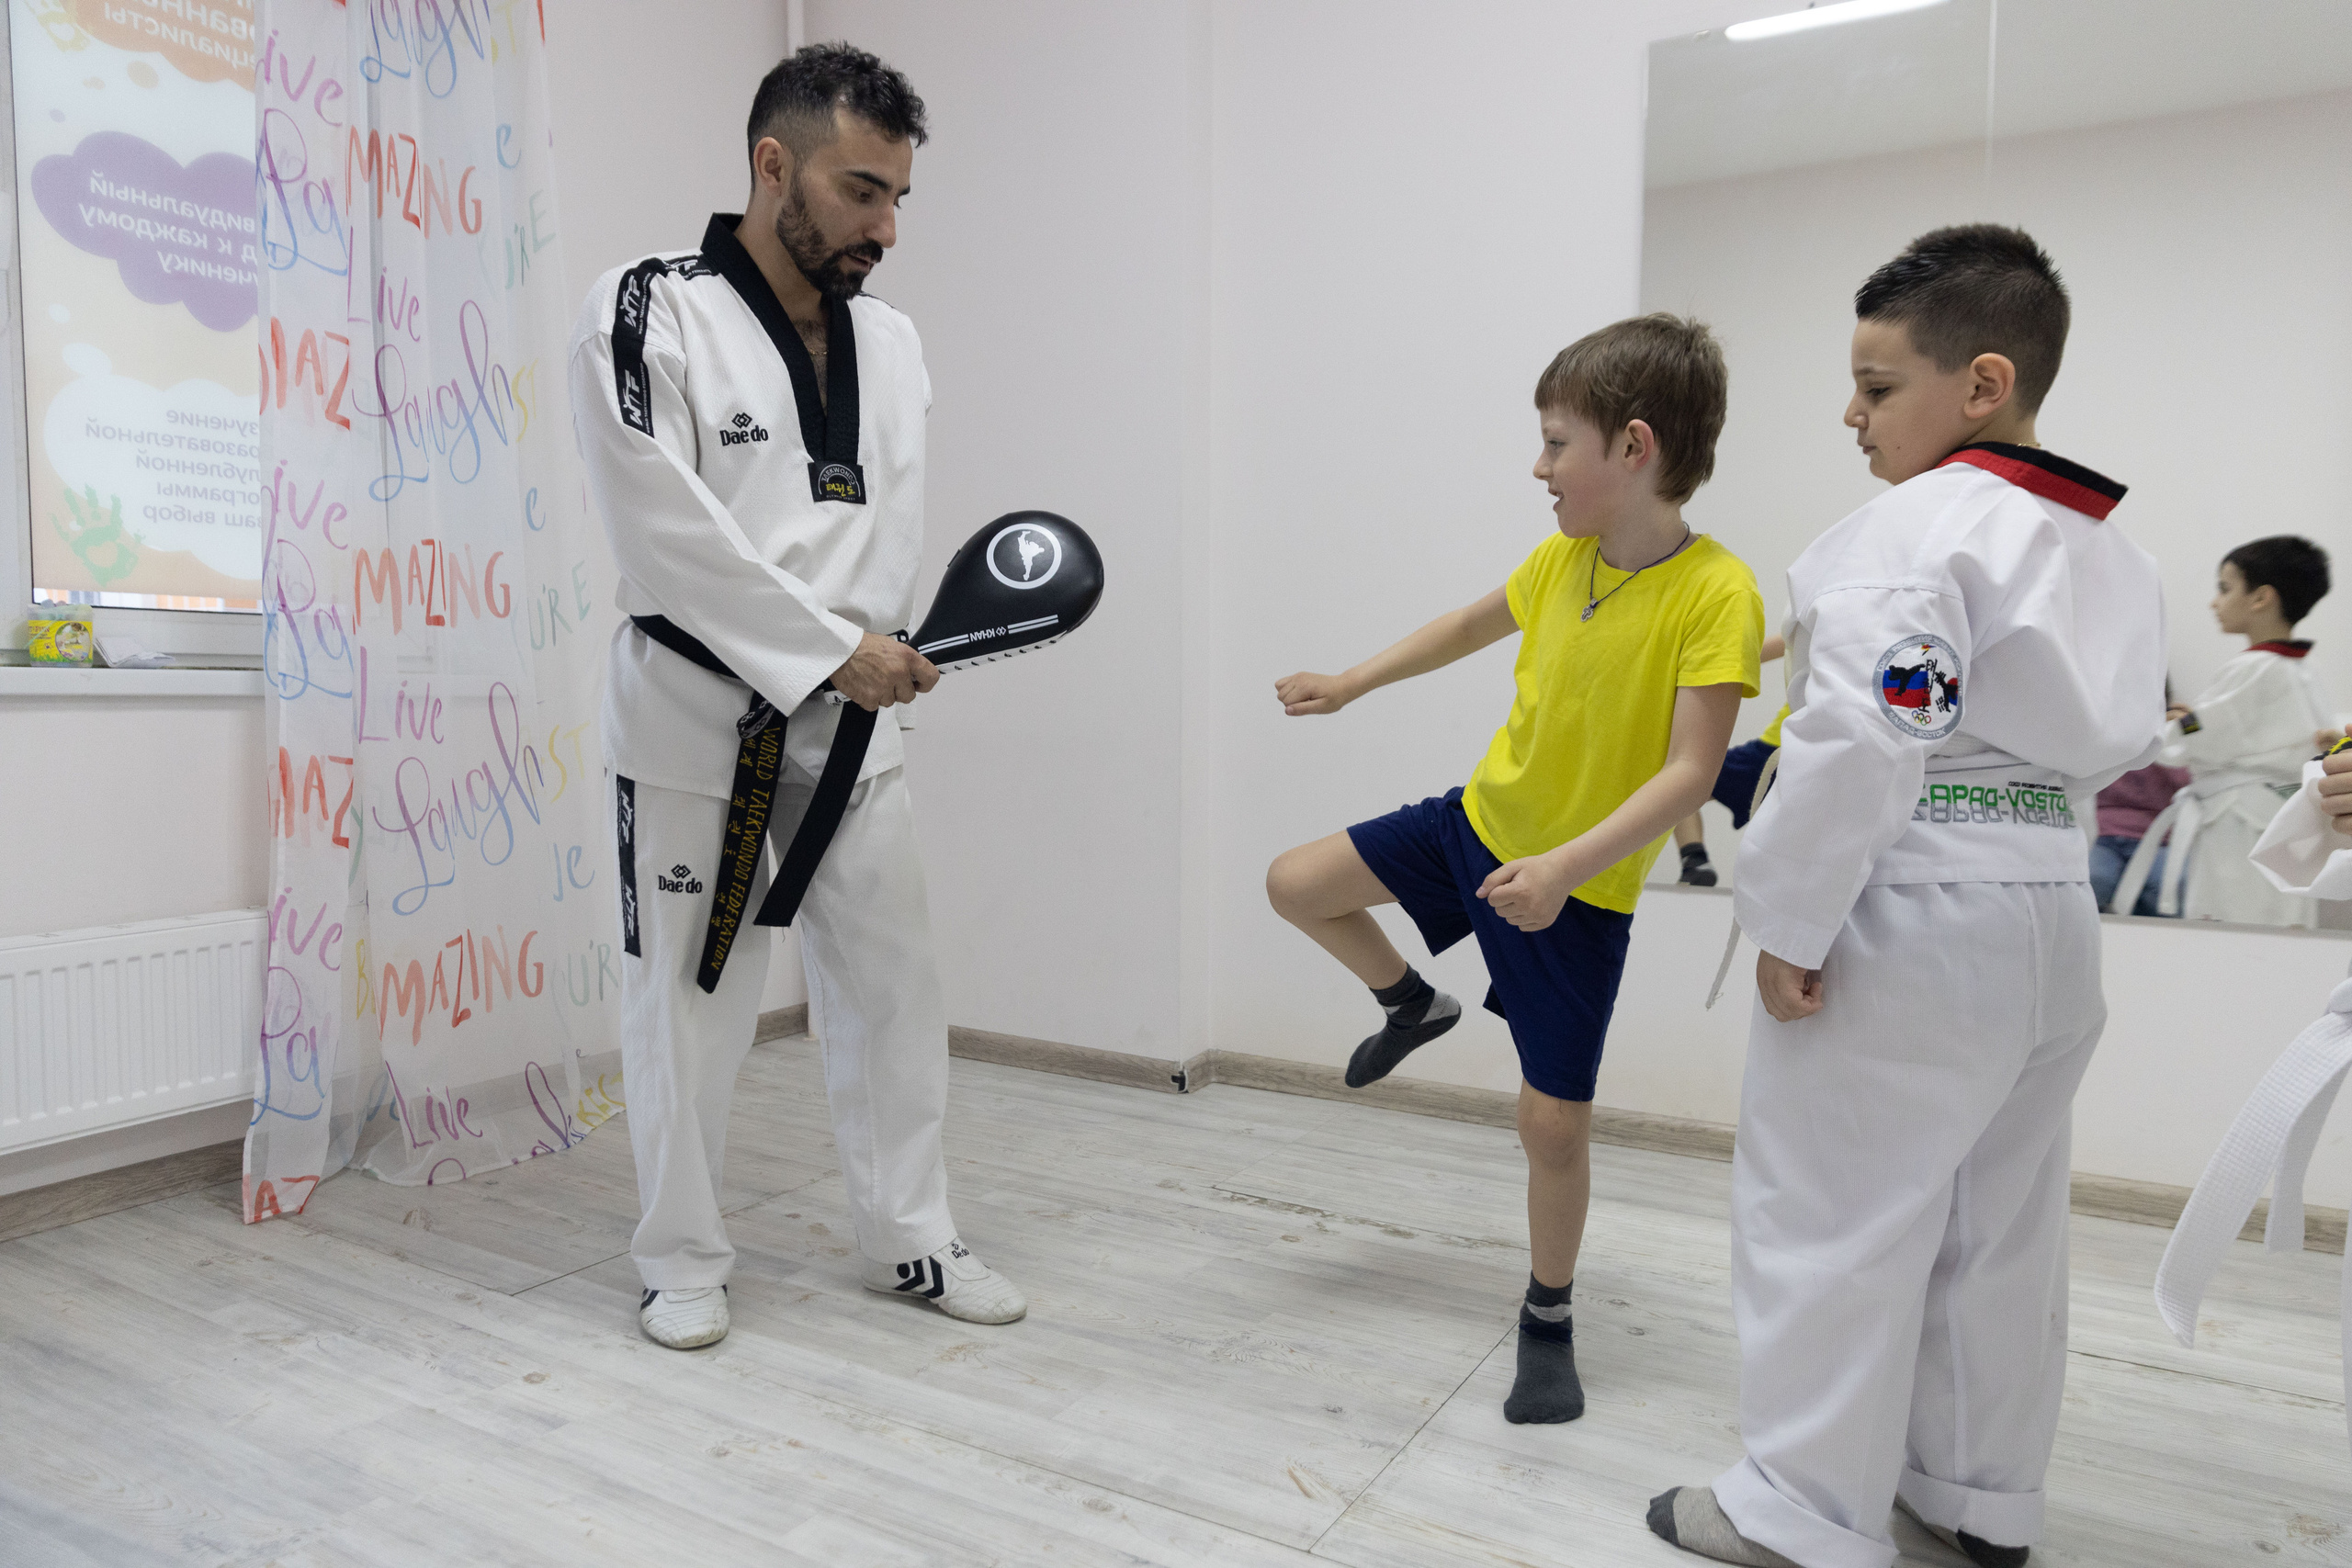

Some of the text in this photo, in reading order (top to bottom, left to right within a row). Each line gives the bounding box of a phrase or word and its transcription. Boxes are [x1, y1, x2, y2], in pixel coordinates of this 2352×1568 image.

[820, 467, 855, 485] TAEKWONDO
[969, 627, 996, 642] KHAN
[710, 727, 781, 971] WORLD TAEKWONDO FEDERATION
[379, 924, 544, 1047] MAZING
